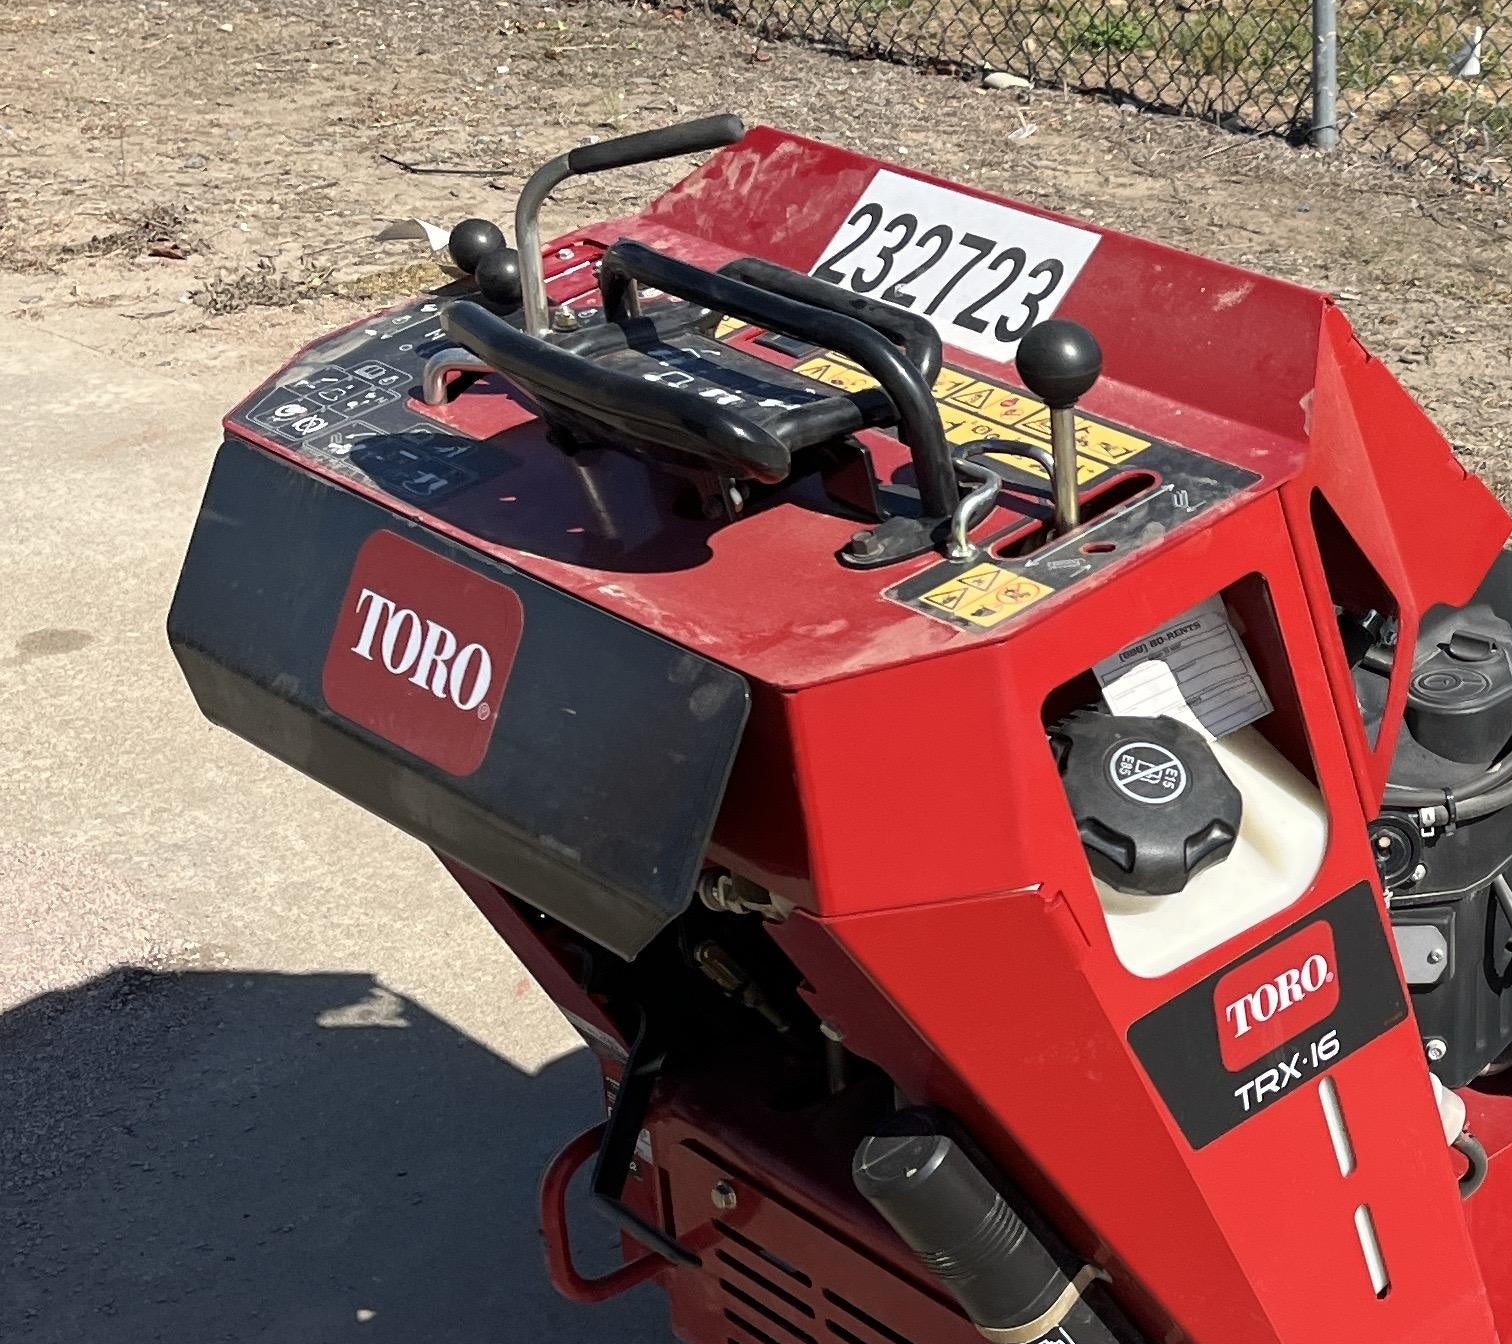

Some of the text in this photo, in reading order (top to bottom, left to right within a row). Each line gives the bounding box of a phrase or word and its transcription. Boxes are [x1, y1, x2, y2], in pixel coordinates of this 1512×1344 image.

[811, 202, 1065, 343] 232723
[350, 587, 493, 713] TORO
[1118, 754, 1135, 776] E85
[1162, 767, 1179, 790] E15
[1225, 953, 1330, 1039] TORO
